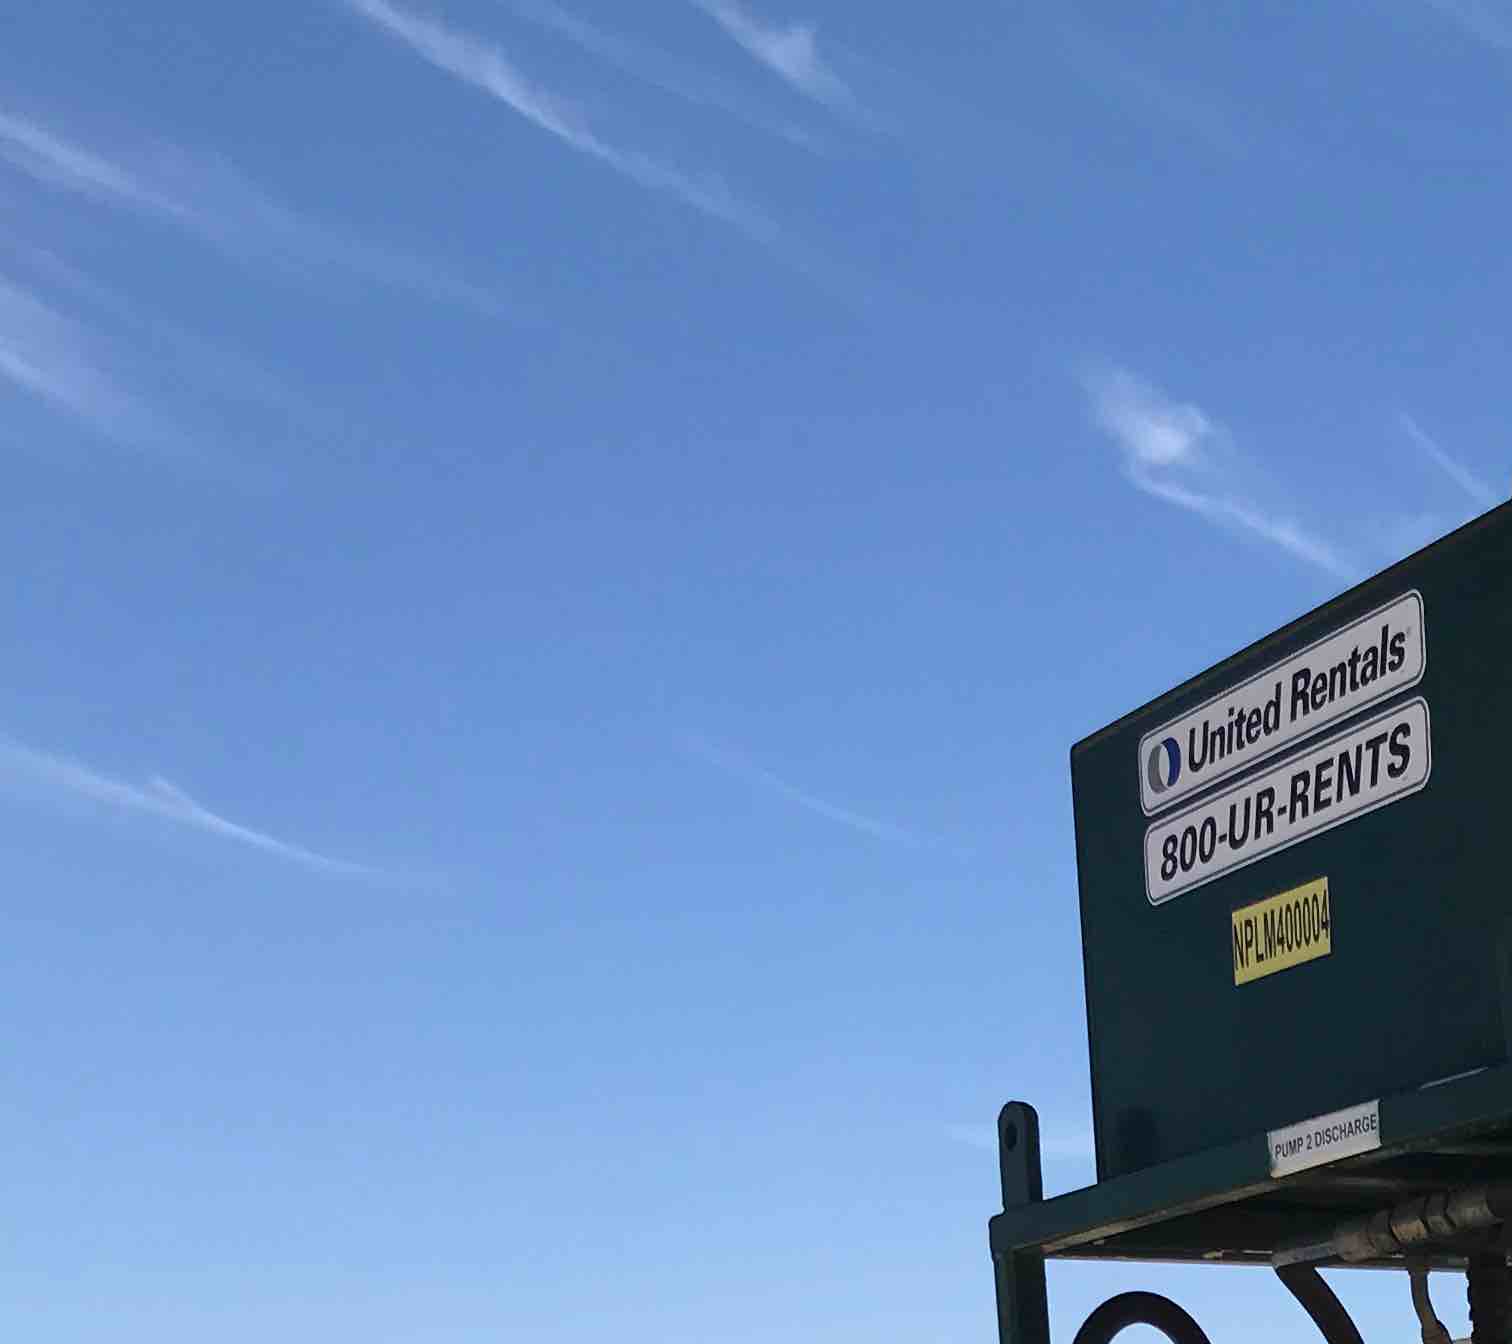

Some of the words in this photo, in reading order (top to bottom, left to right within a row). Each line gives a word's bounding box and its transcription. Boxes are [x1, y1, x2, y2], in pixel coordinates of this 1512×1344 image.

[1188, 682, 1283, 773] United
[1290, 624, 1406, 723] Rentals
[1160, 722, 1412, 882] 800-UR-RENTS
[1233, 889, 1329, 970] NPLM400004
[1274, 1137, 1304, 1159] PUMP
[1306, 1134, 1313, 1150] 2
[1314, 1113, 1377, 1148] DISCHARGE
